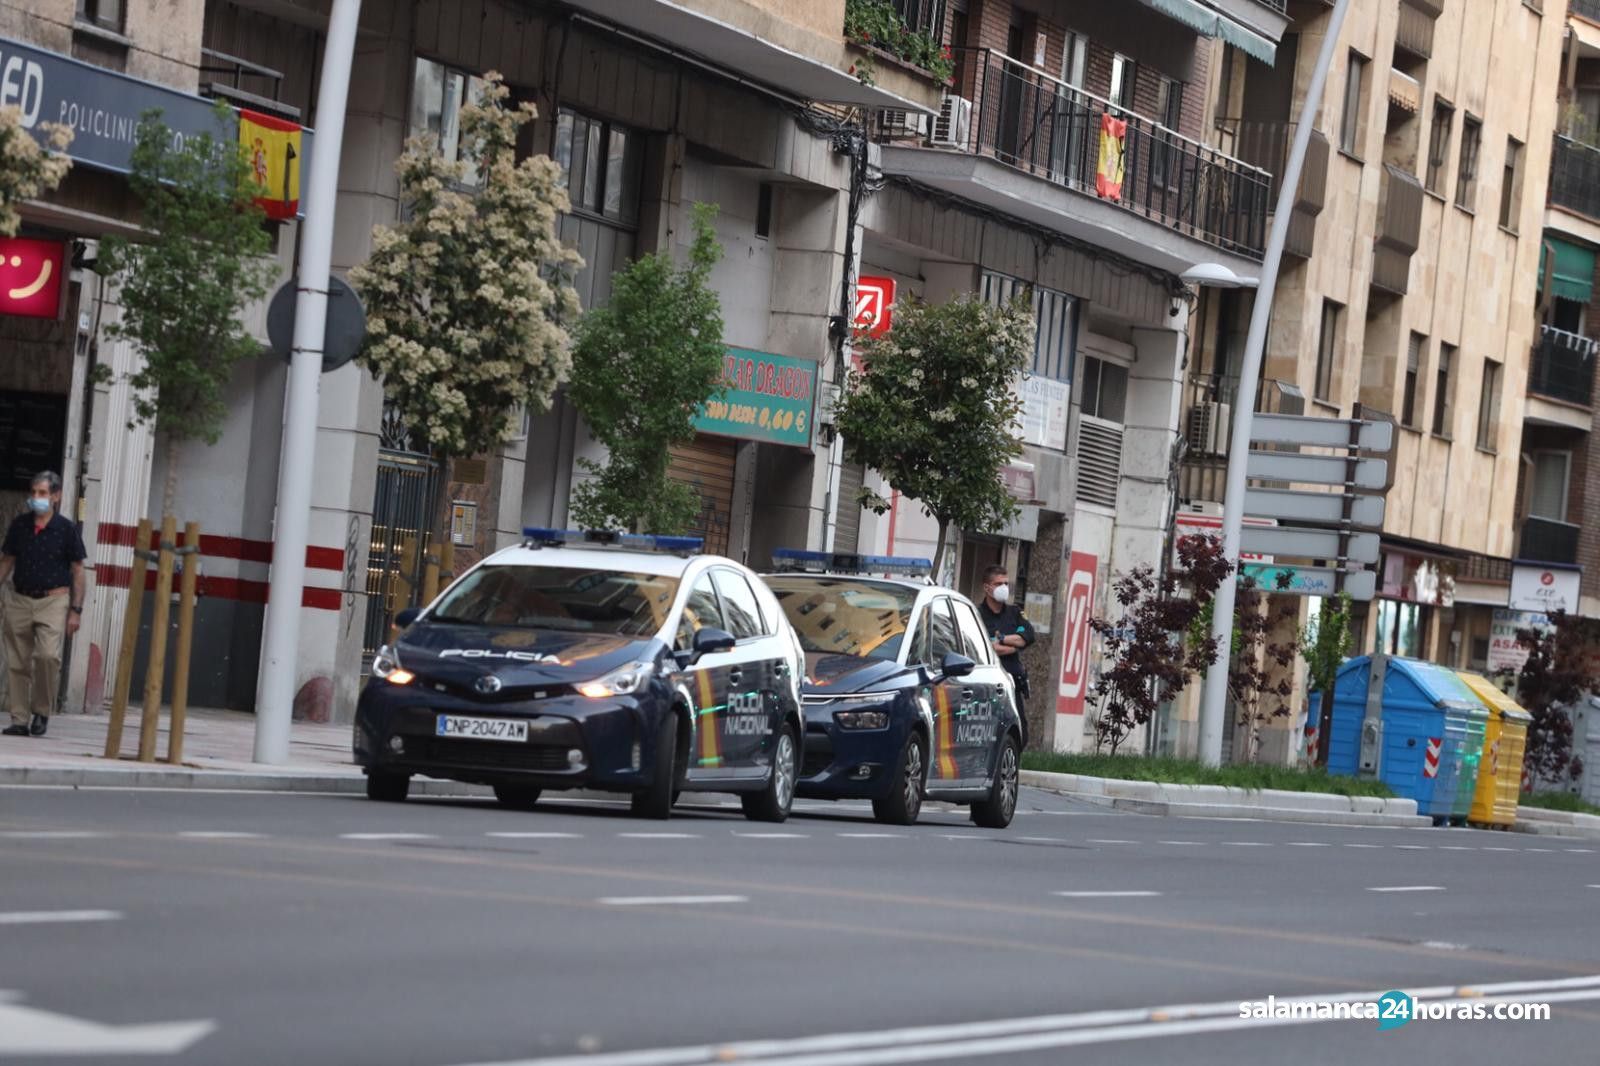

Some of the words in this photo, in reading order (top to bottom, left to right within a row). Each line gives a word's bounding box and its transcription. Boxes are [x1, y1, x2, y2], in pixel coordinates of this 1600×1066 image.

[756, 361, 812, 399] DRAGON
[724, 716, 773, 736] NACIONAL
[956, 725, 997, 742] NACIONAL
